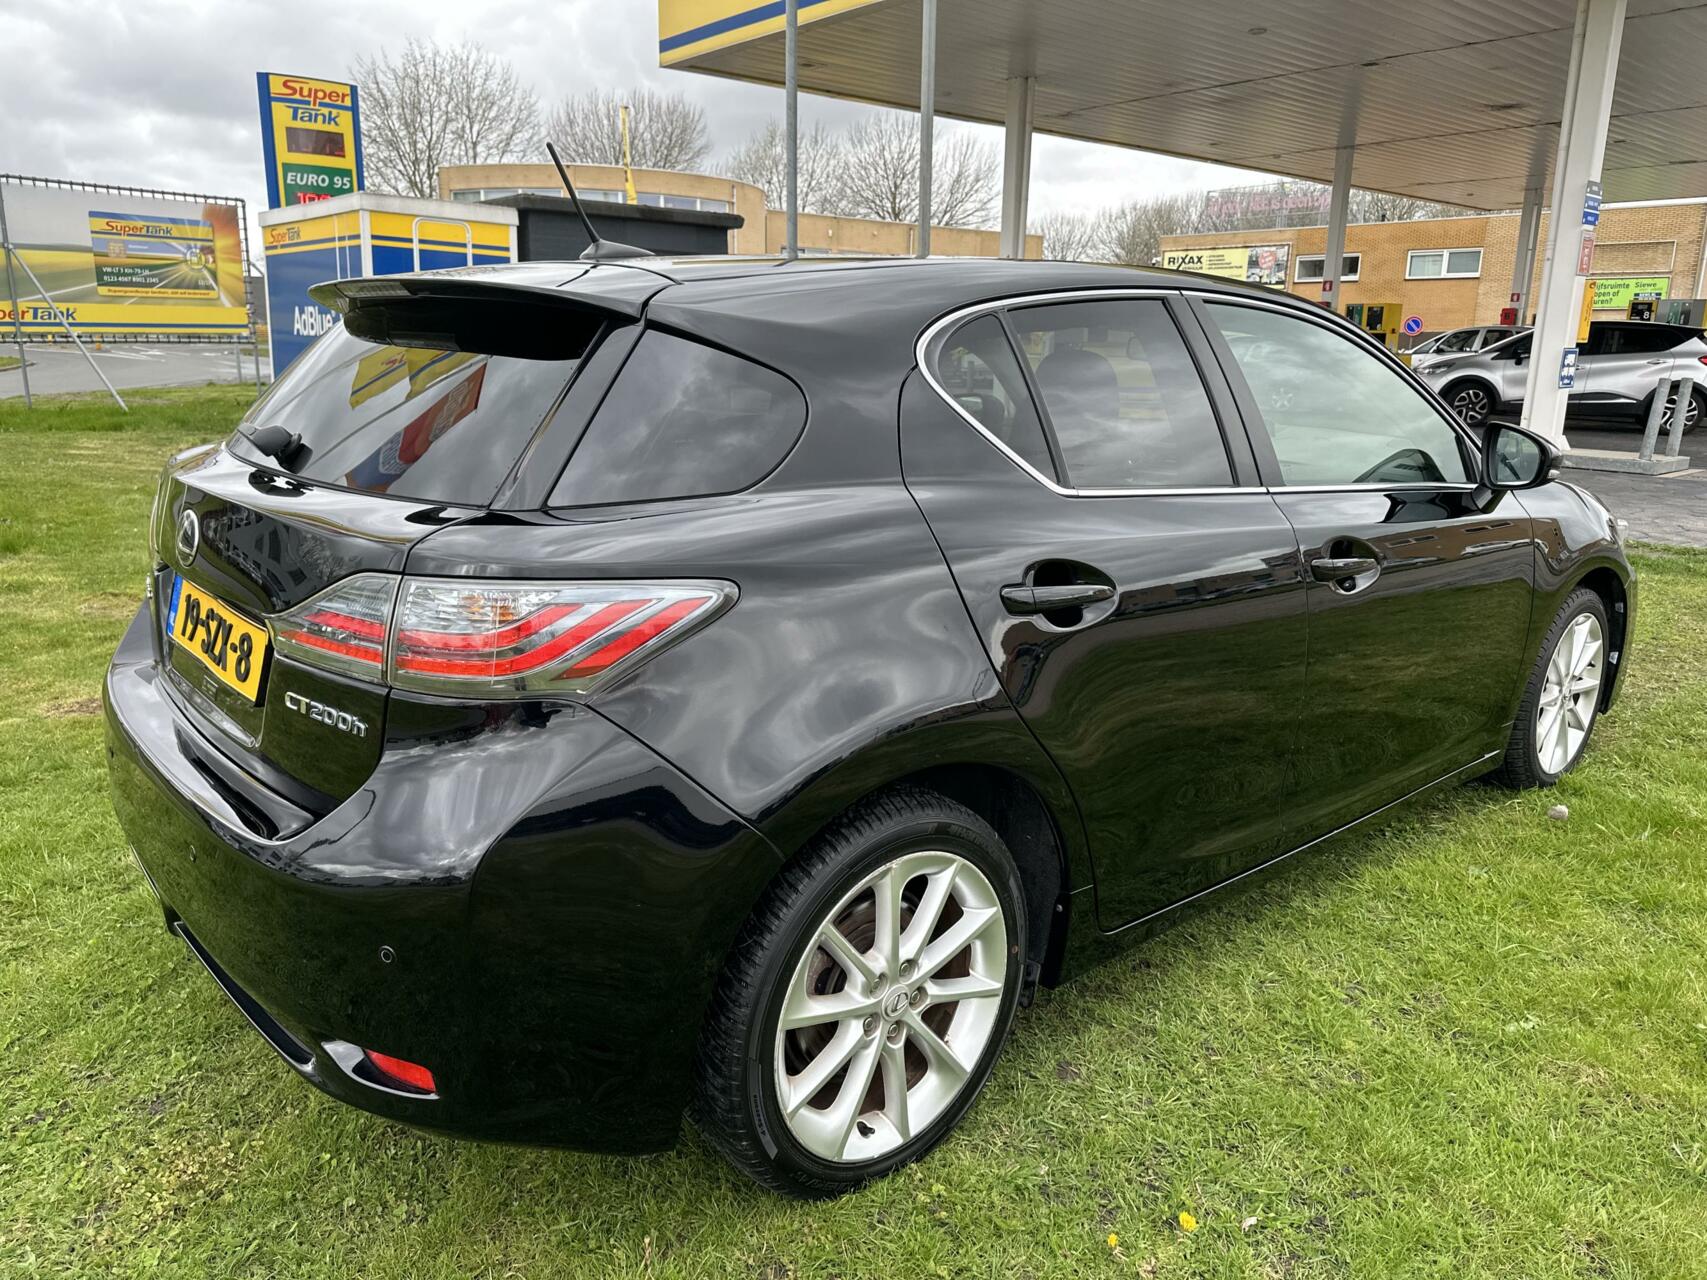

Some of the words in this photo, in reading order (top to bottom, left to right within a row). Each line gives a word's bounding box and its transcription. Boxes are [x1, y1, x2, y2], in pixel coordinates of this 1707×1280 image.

[270, 79, 350, 107] Super
[284, 105, 340, 126] Tank
[286, 172, 329, 187] EURO
[334, 176, 351, 189] 95
[101, 220, 173, 237] SuperTank
[1597, 282, 1630, 291] ijfsruimte
[294, 305, 333, 336] AdBlue
[1643, 311, 1650, 320] 8
[180, 593, 253, 683] 19-SZX-8
